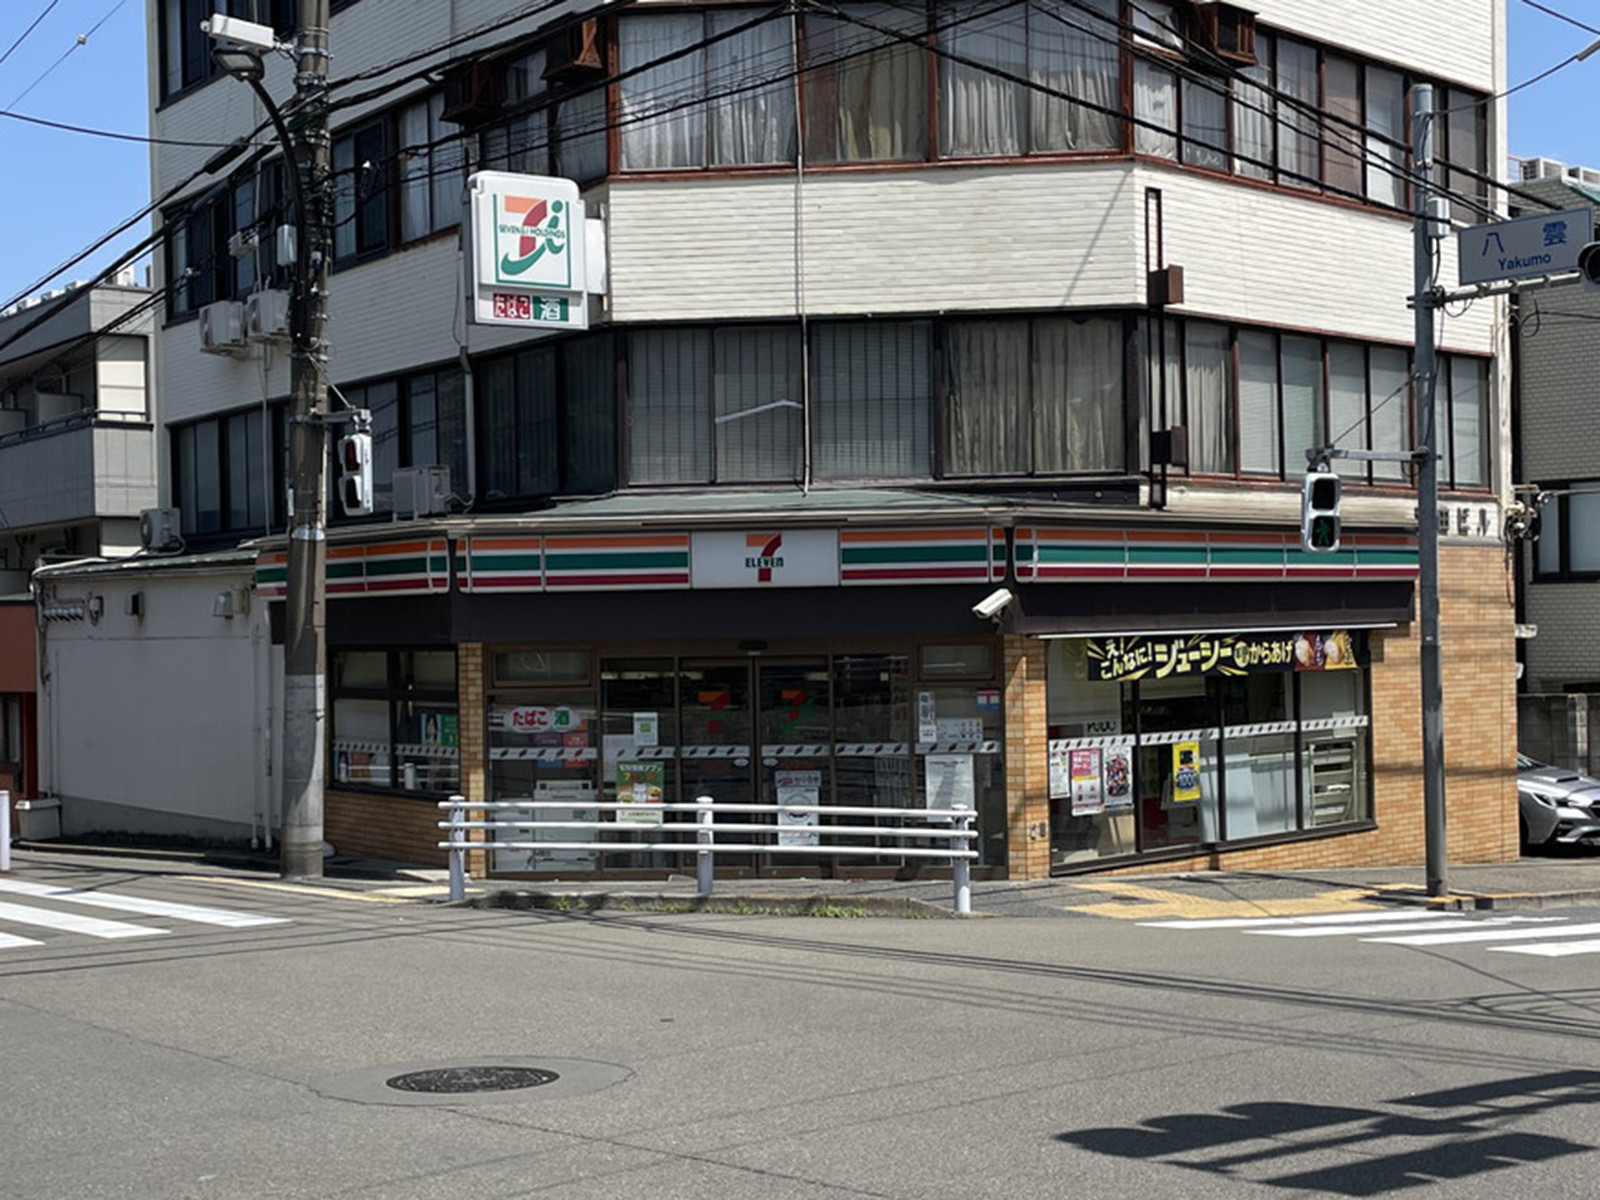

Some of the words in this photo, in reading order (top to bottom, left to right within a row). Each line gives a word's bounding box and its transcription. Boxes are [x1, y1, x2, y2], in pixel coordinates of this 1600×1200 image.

[530, 228, 566, 239] HOLDINGS
[1482, 221, 1566, 256] 八雲
[1498, 254, 1552, 271] Yakumo
[494, 294, 529, 318] たばこ
[540, 297, 560, 320] 酒
[512, 710, 548, 726] たばこ
[554, 710, 570, 726] 酒
